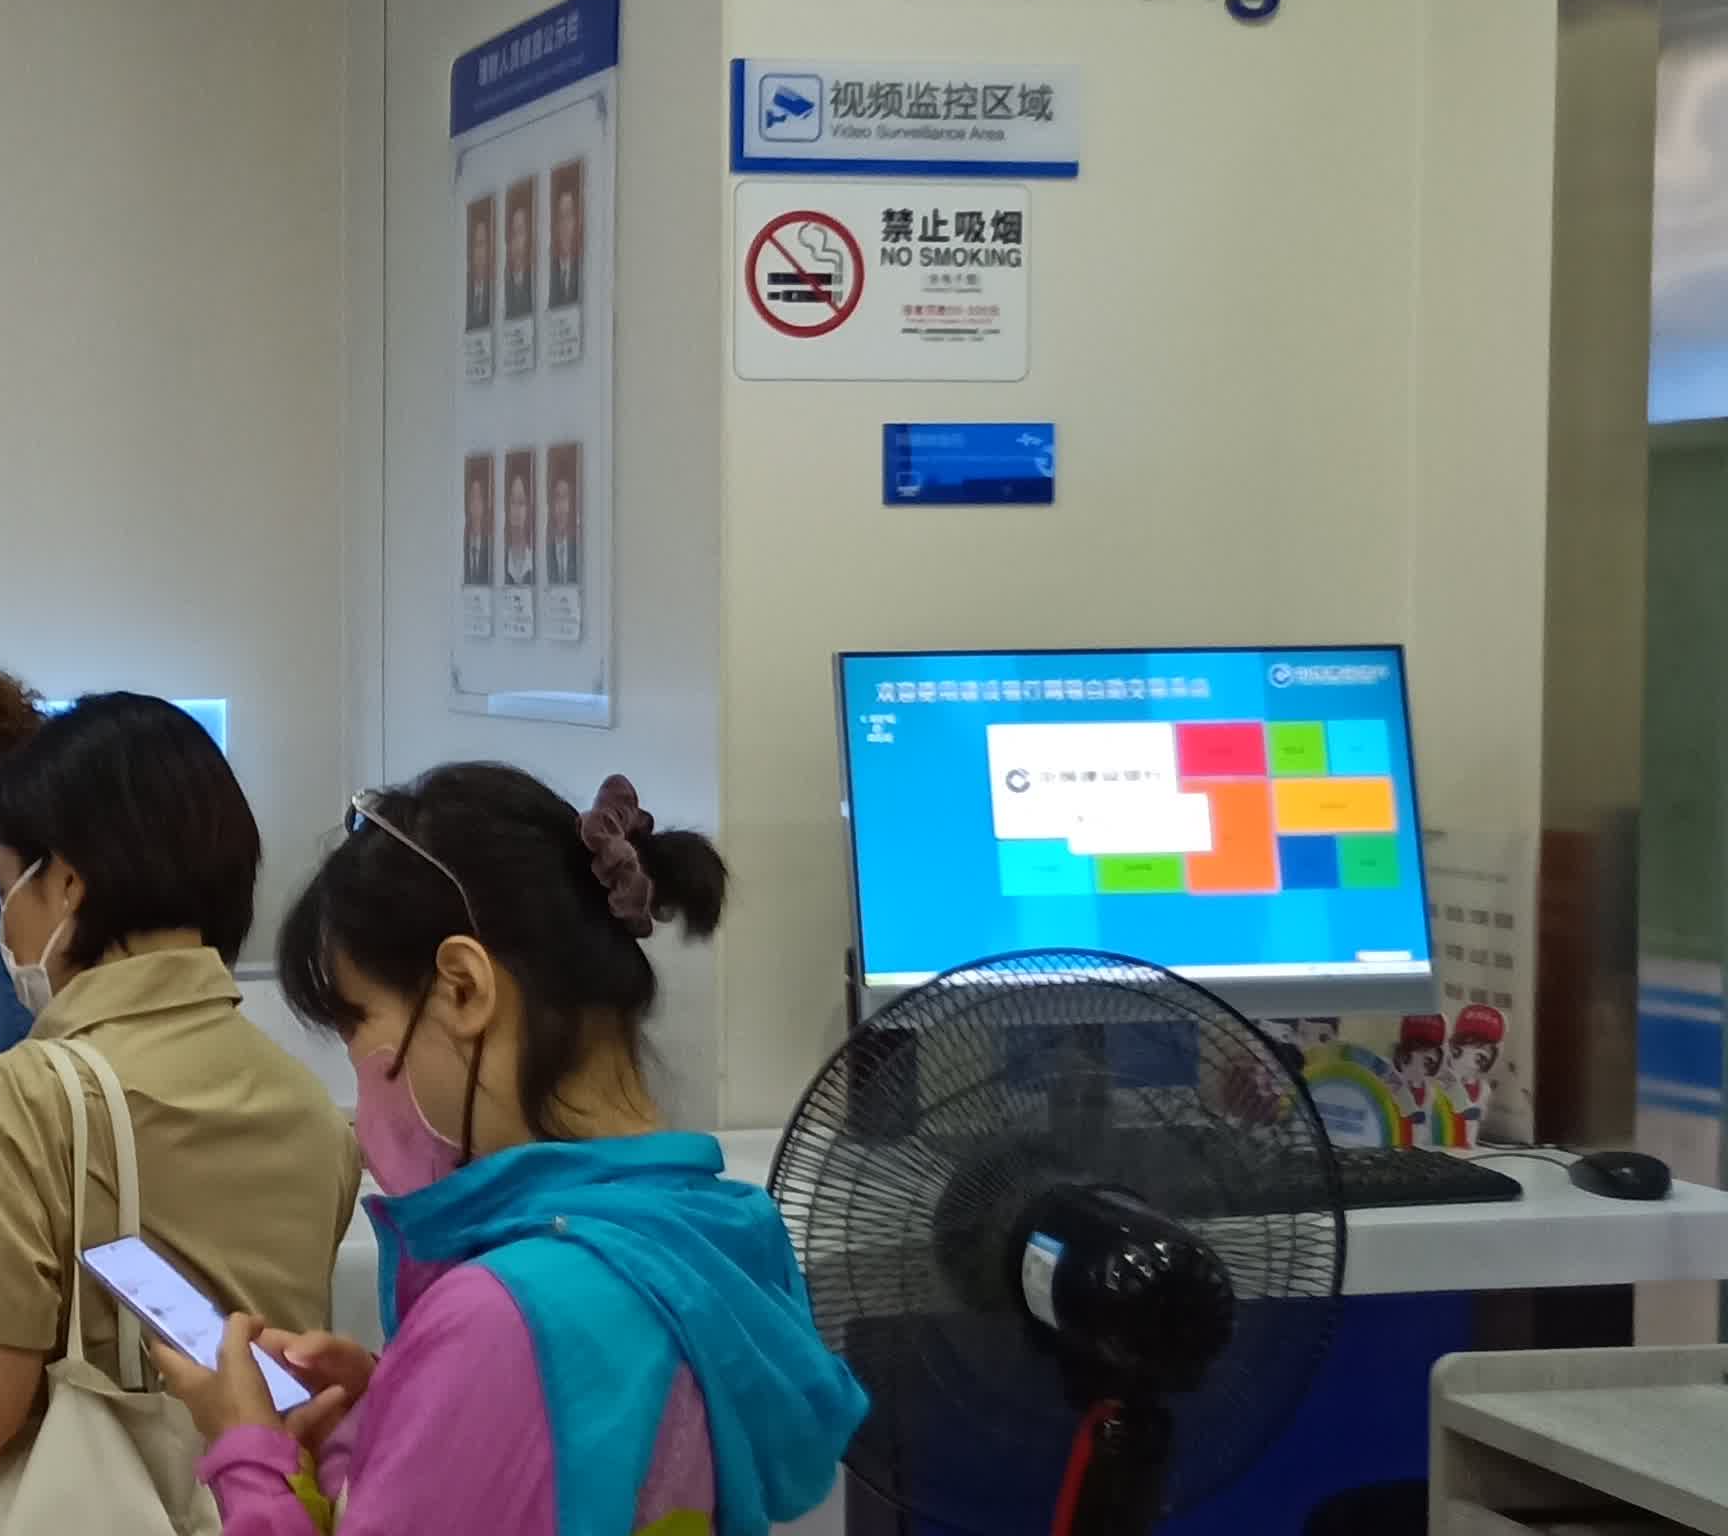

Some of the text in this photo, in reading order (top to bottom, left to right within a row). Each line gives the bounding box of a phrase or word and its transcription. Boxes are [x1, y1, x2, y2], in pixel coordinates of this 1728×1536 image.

[830, 80, 1054, 122] 视频监控区域
[830, 123, 873, 139] Video
[967, 125, 1005, 142] Area
[881, 207, 1023, 244] 禁止吸烟
[880, 247, 1022, 268] NO SMOKING
